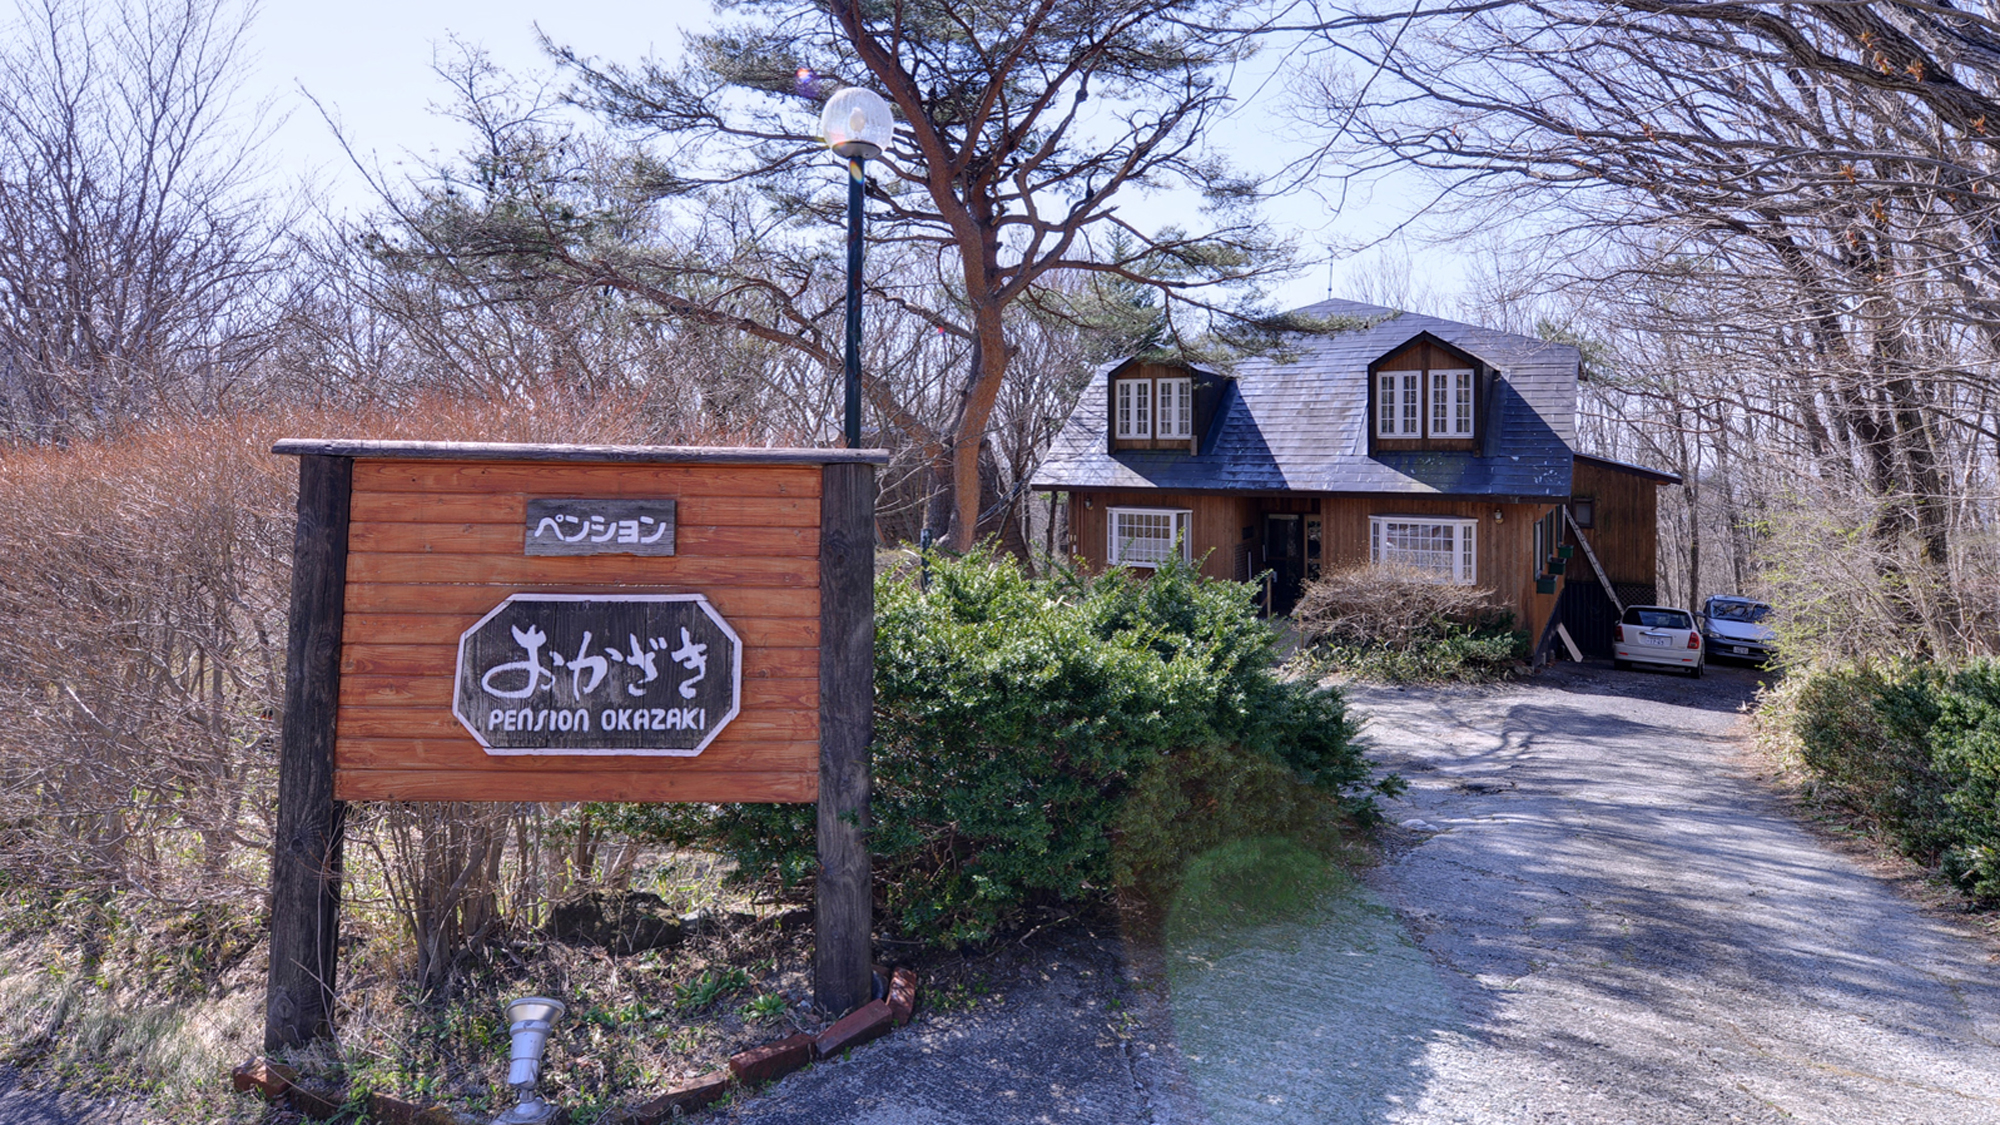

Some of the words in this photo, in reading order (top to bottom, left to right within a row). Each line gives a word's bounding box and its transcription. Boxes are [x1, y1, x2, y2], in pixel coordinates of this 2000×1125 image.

[481, 624, 708, 700] おかざき
[489, 709, 590, 732] PENSION
[601, 708, 706, 731] OKAZAKI
